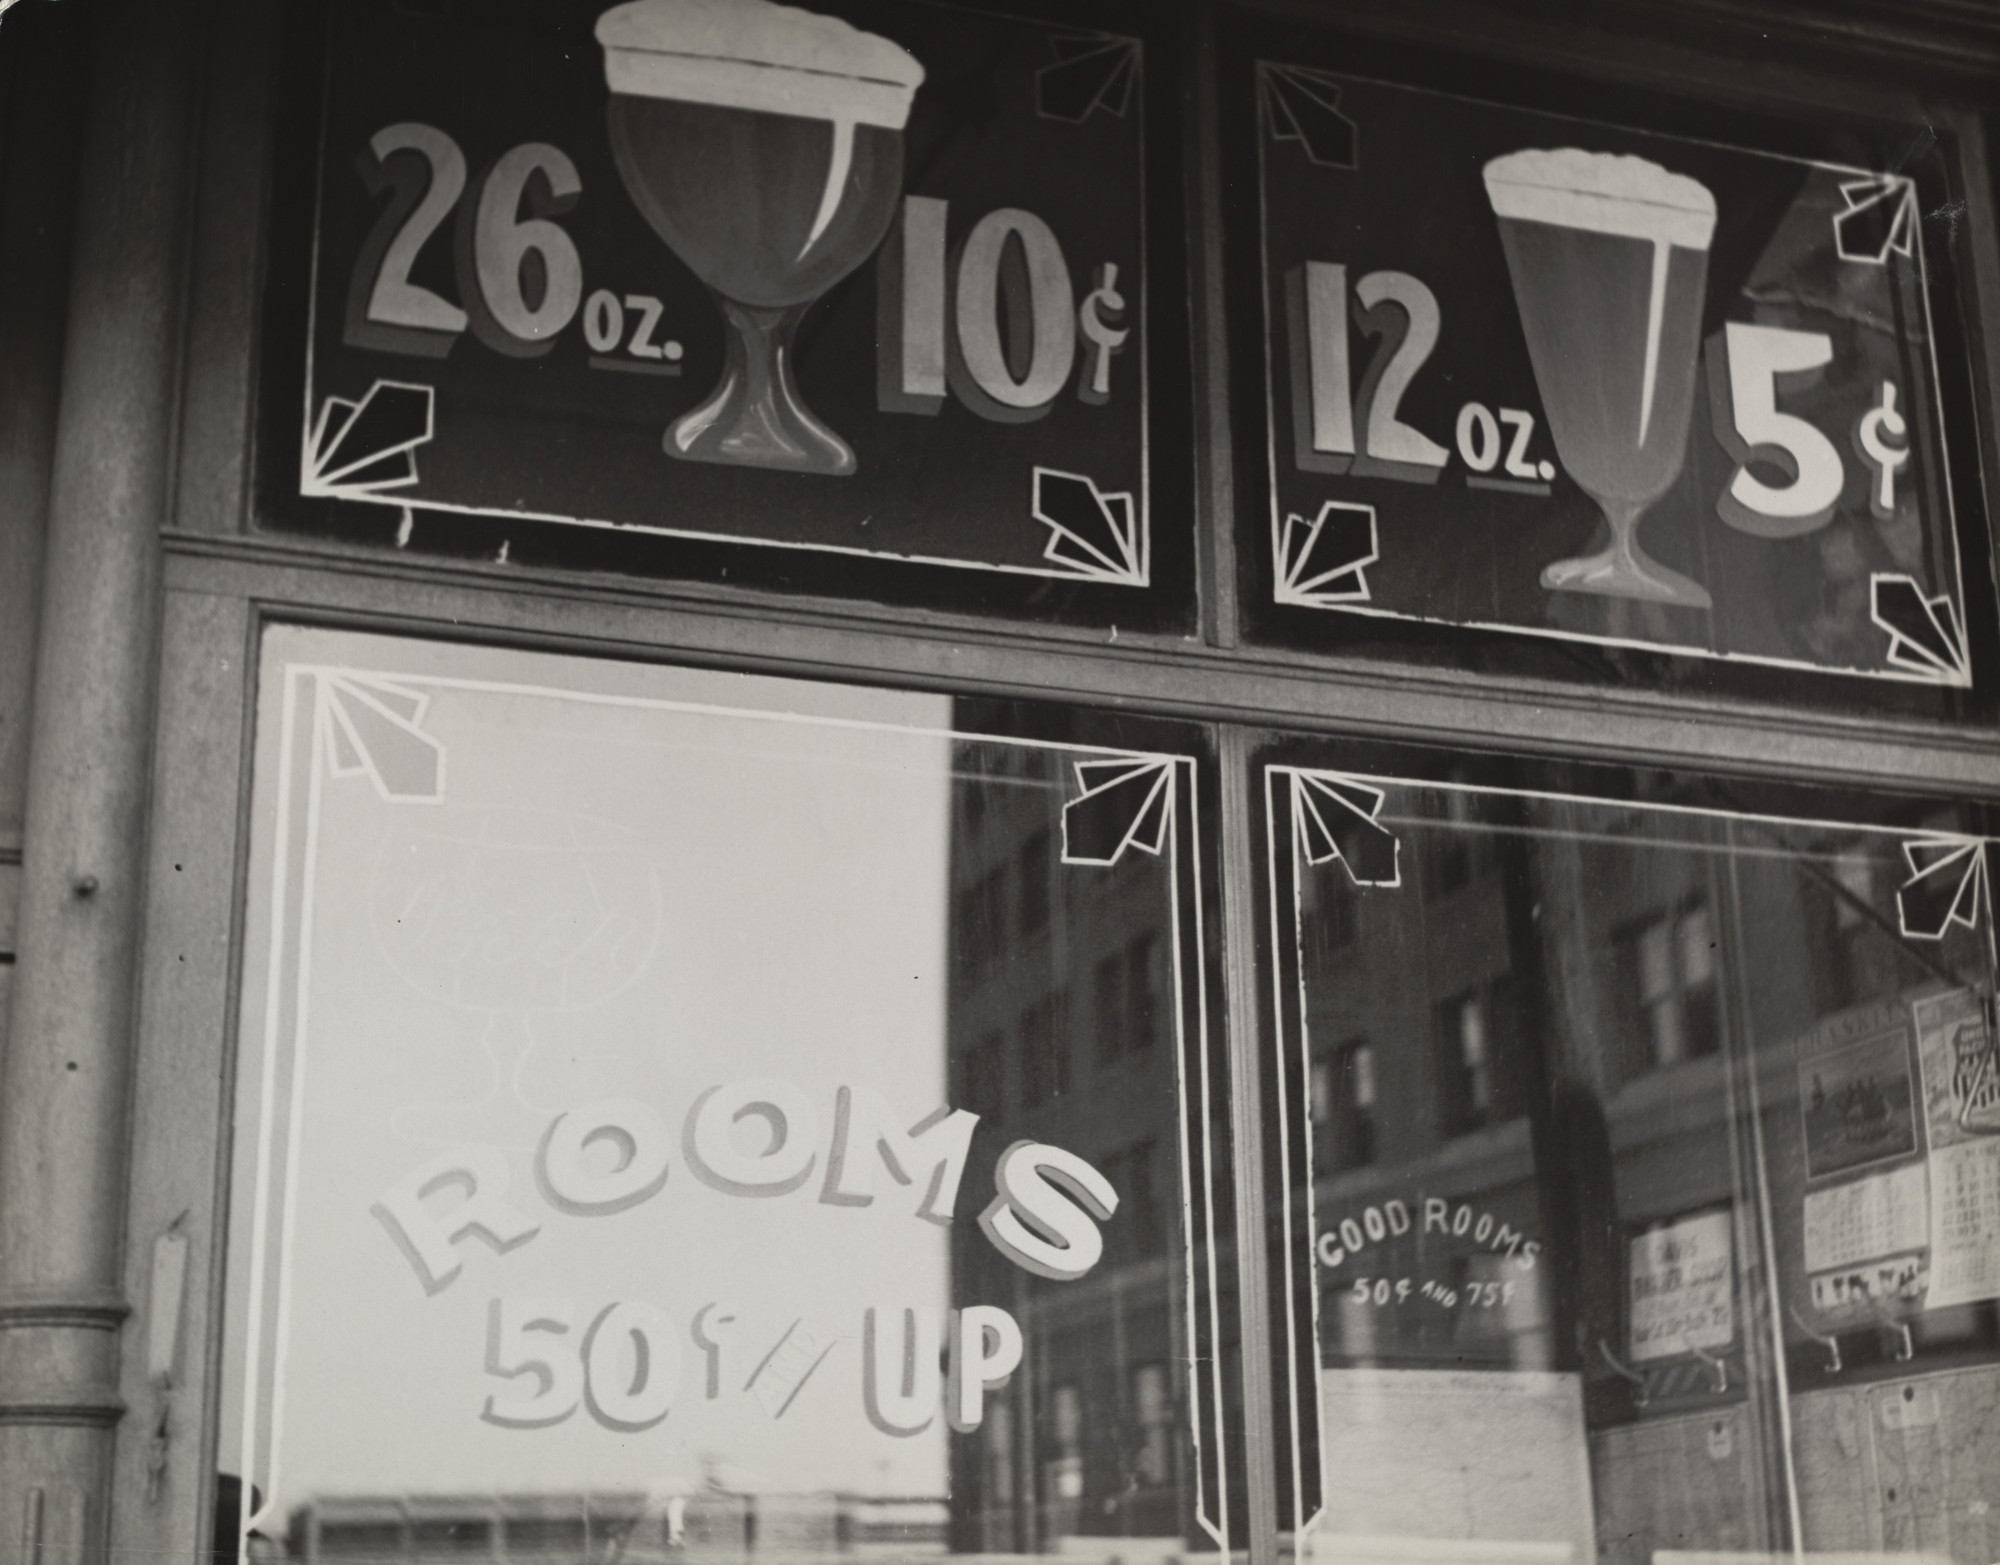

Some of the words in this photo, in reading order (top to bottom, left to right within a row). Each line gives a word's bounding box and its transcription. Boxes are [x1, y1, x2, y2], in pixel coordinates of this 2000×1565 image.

[346, 122, 583, 358] 26
[877, 195, 1131, 424] 10¢
[1285, 260, 1450, 484] 12
[1704, 322, 1910, 538] 5¢
[370, 1077, 1121, 1297] ROOMS
[1317, 1198, 1412, 1268] GOOD
[1424, 1197, 1542, 1271] ROOMS
[862, 1304, 1022, 1439] UP
